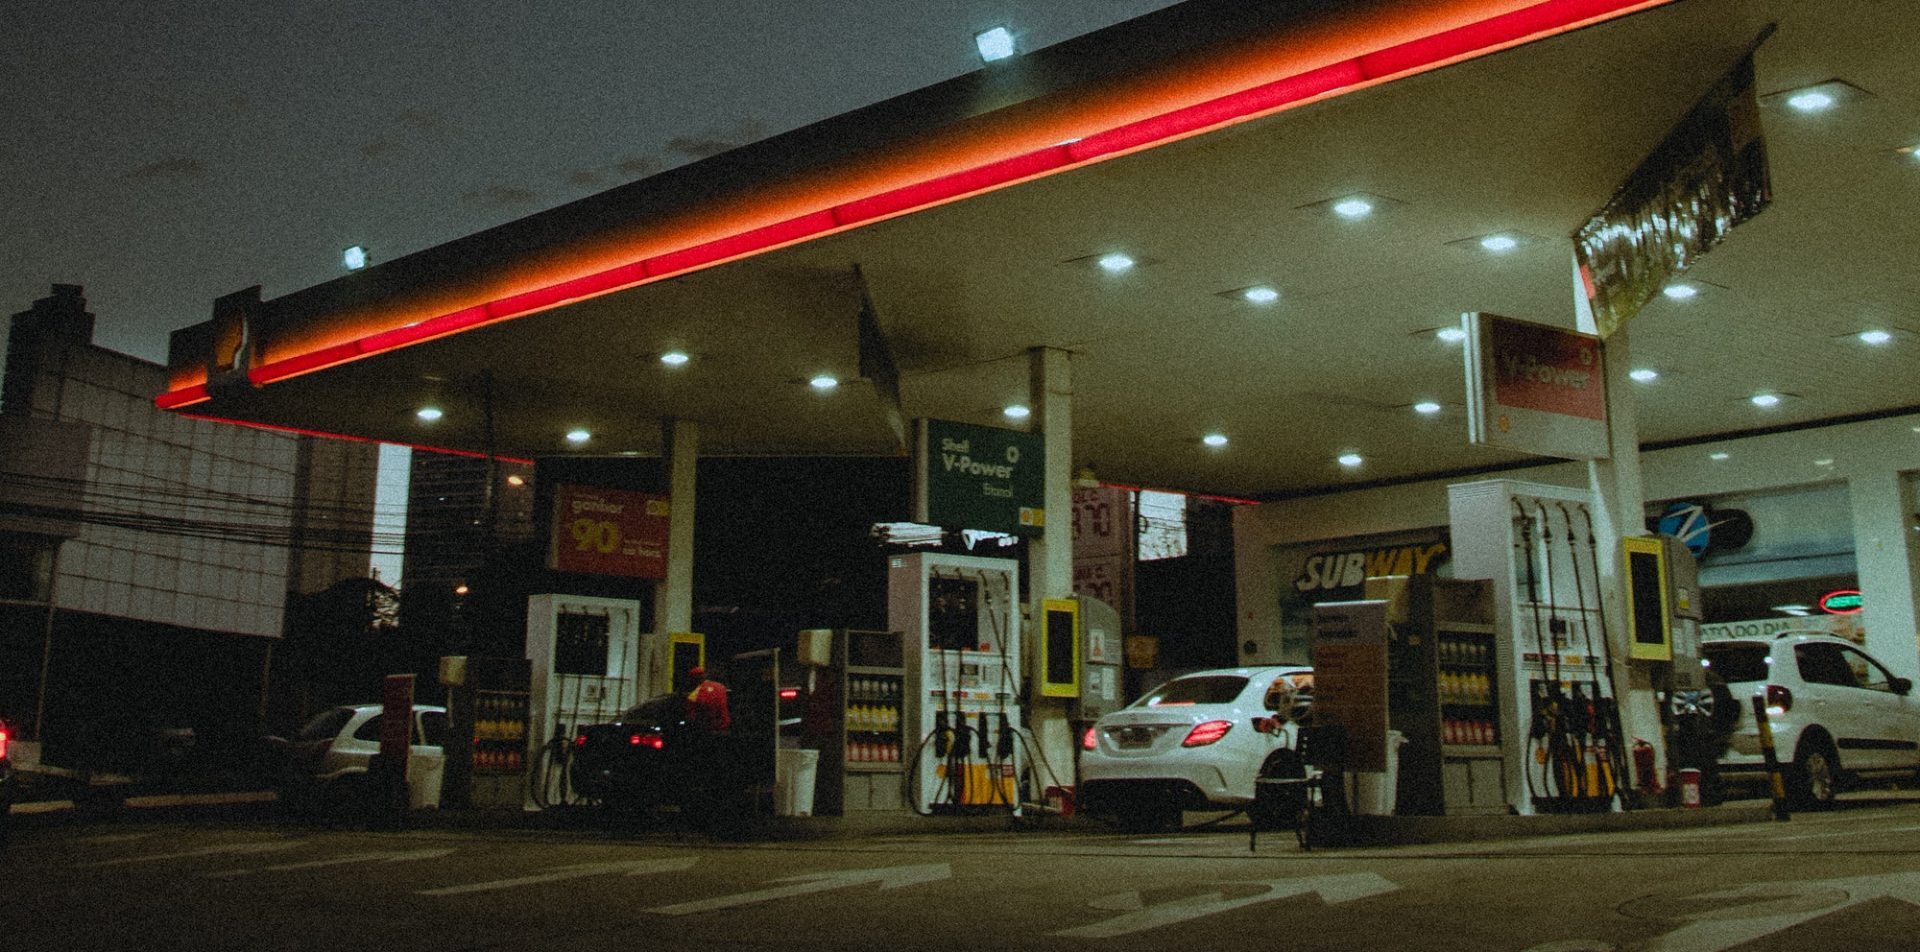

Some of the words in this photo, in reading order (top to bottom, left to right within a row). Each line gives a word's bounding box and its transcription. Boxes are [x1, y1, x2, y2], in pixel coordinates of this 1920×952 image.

[942, 438, 970, 453] Shell
[942, 453, 1014, 479] V-Power
[571, 517, 620, 554] 90
[1296, 543, 1447, 592] SUBWAY
